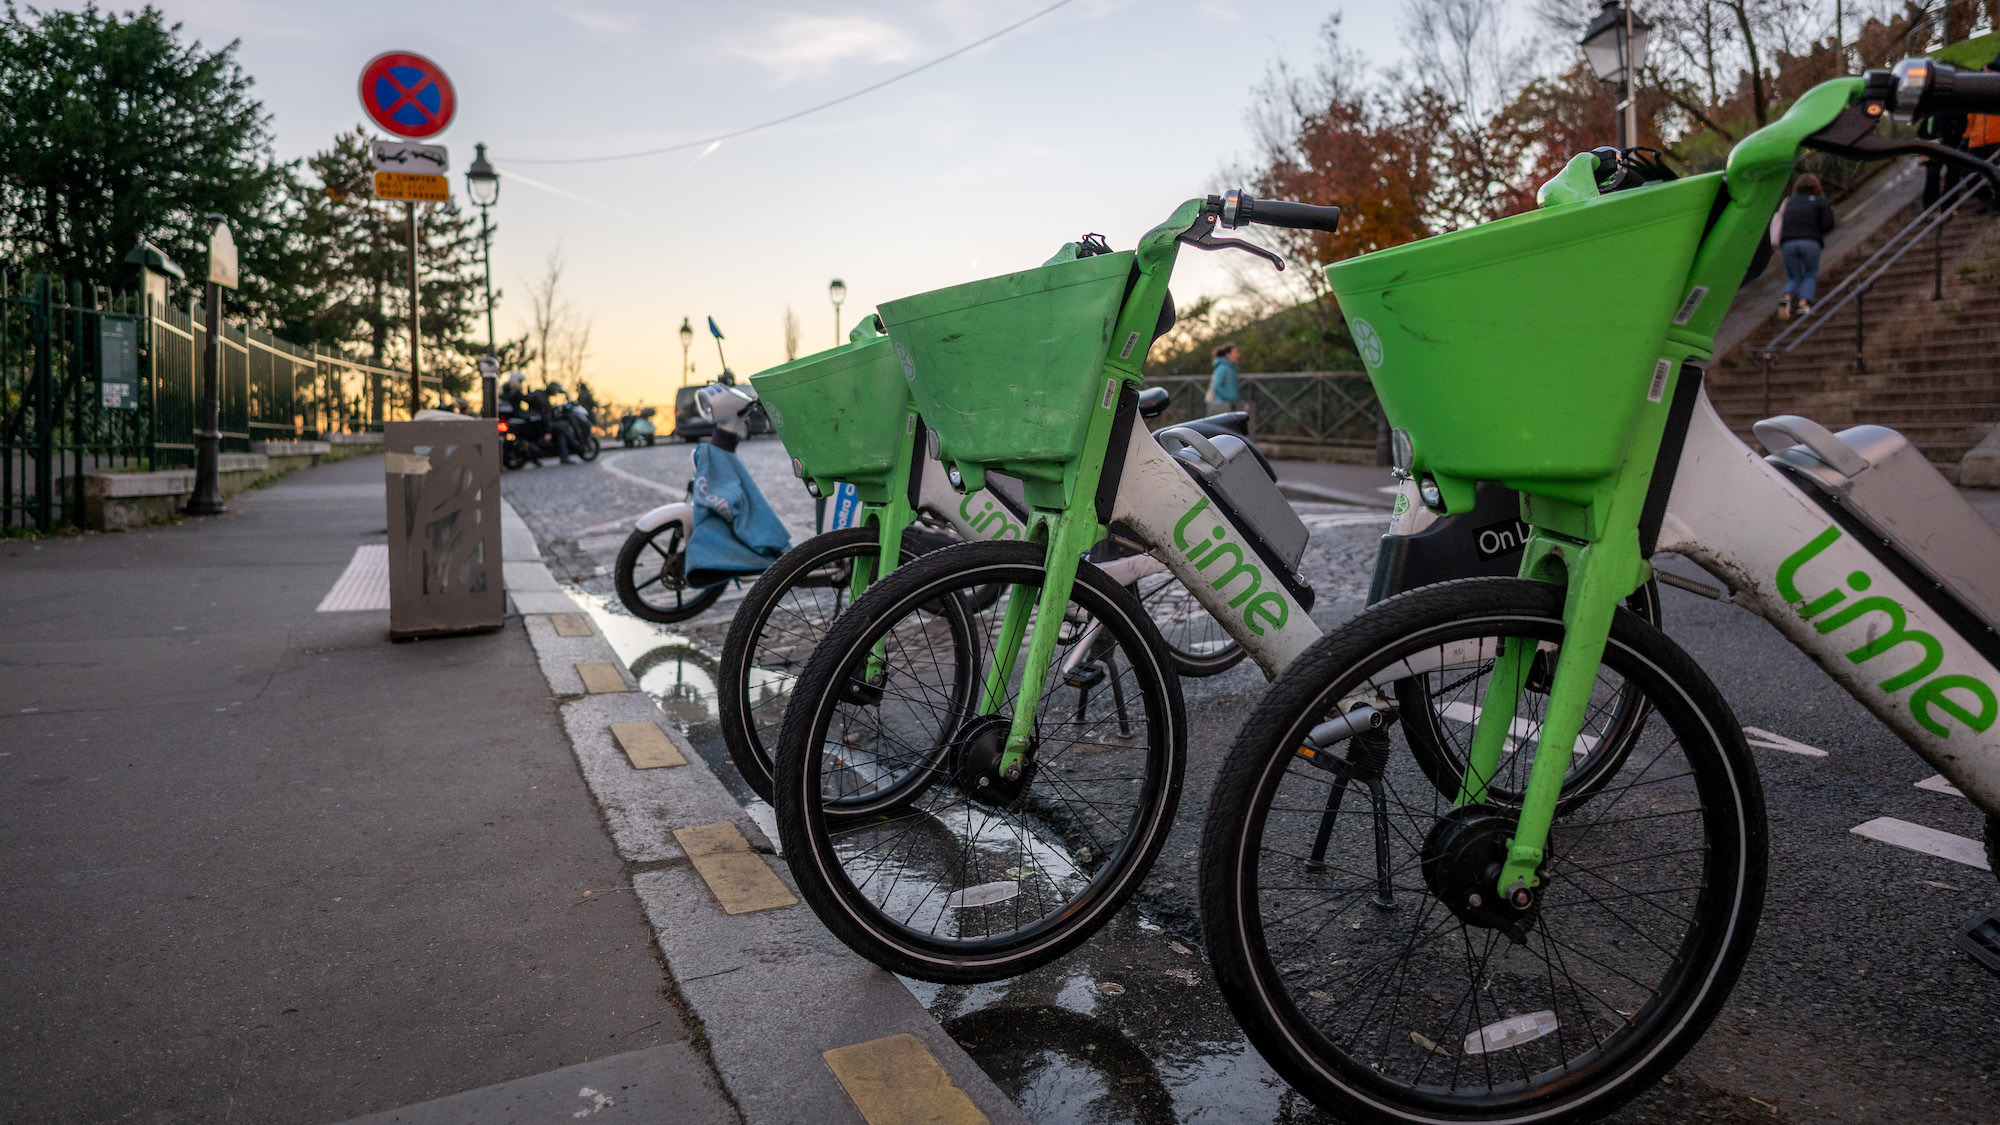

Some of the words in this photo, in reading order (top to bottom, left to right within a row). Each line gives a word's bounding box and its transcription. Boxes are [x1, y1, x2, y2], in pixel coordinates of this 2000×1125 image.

[380, 190, 404, 198] POUR
[959, 491, 1021, 541] Lim
[1479, 530, 1516, 554] On
[1515, 521, 1530, 544] L
[1173, 495, 1289, 637] Lime
[1775, 524, 1999, 740] Lime
